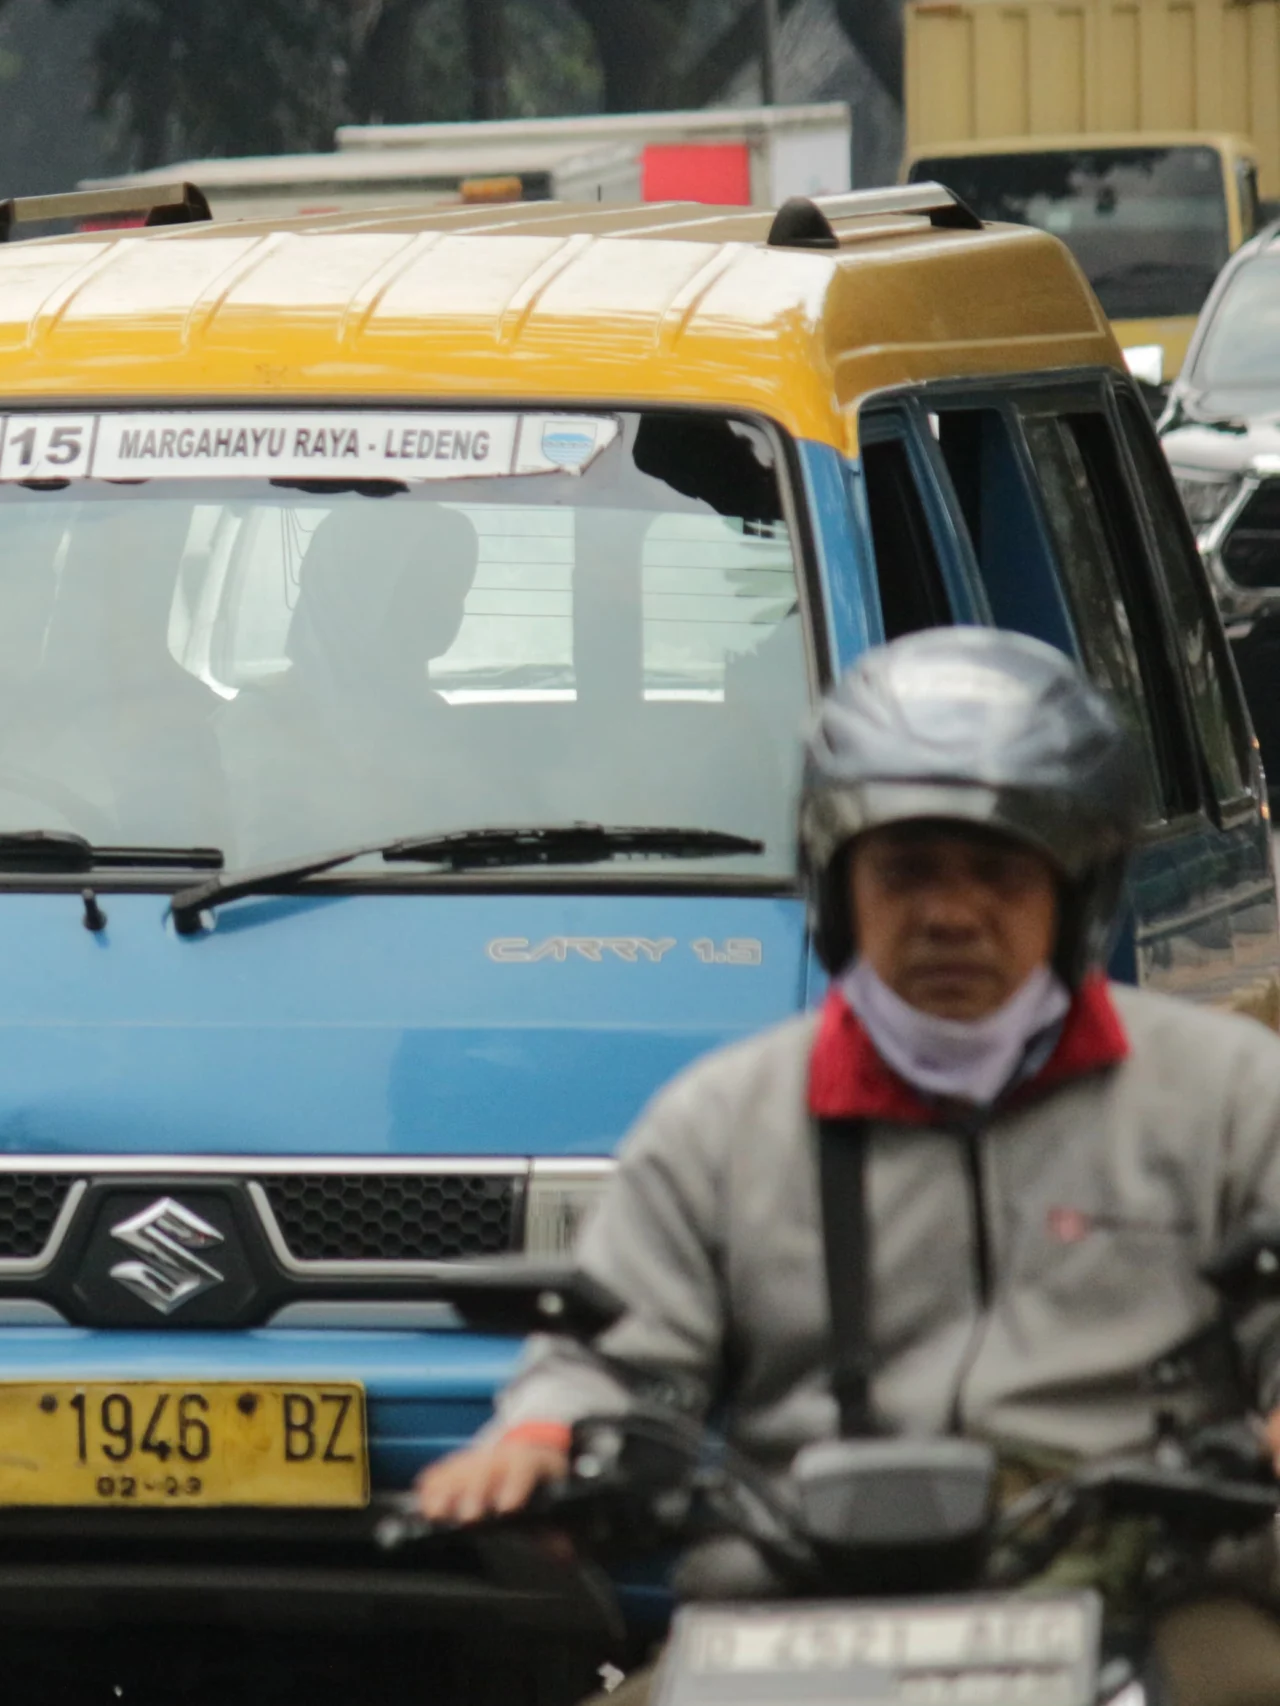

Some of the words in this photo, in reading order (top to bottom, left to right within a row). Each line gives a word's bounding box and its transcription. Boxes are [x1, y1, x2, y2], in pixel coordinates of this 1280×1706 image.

[9, 425, 84, 466] 15
[117, 427, 286, 460] MARGAHAYU
[292, 428, 360, 459] RAYA
[384, 428, 491, 461] LEDENG
[487, 937, 677, 963] CARRY
[70, 1392, 211, 1465] 1946
[282, 1392, 356, 1464] BZ
